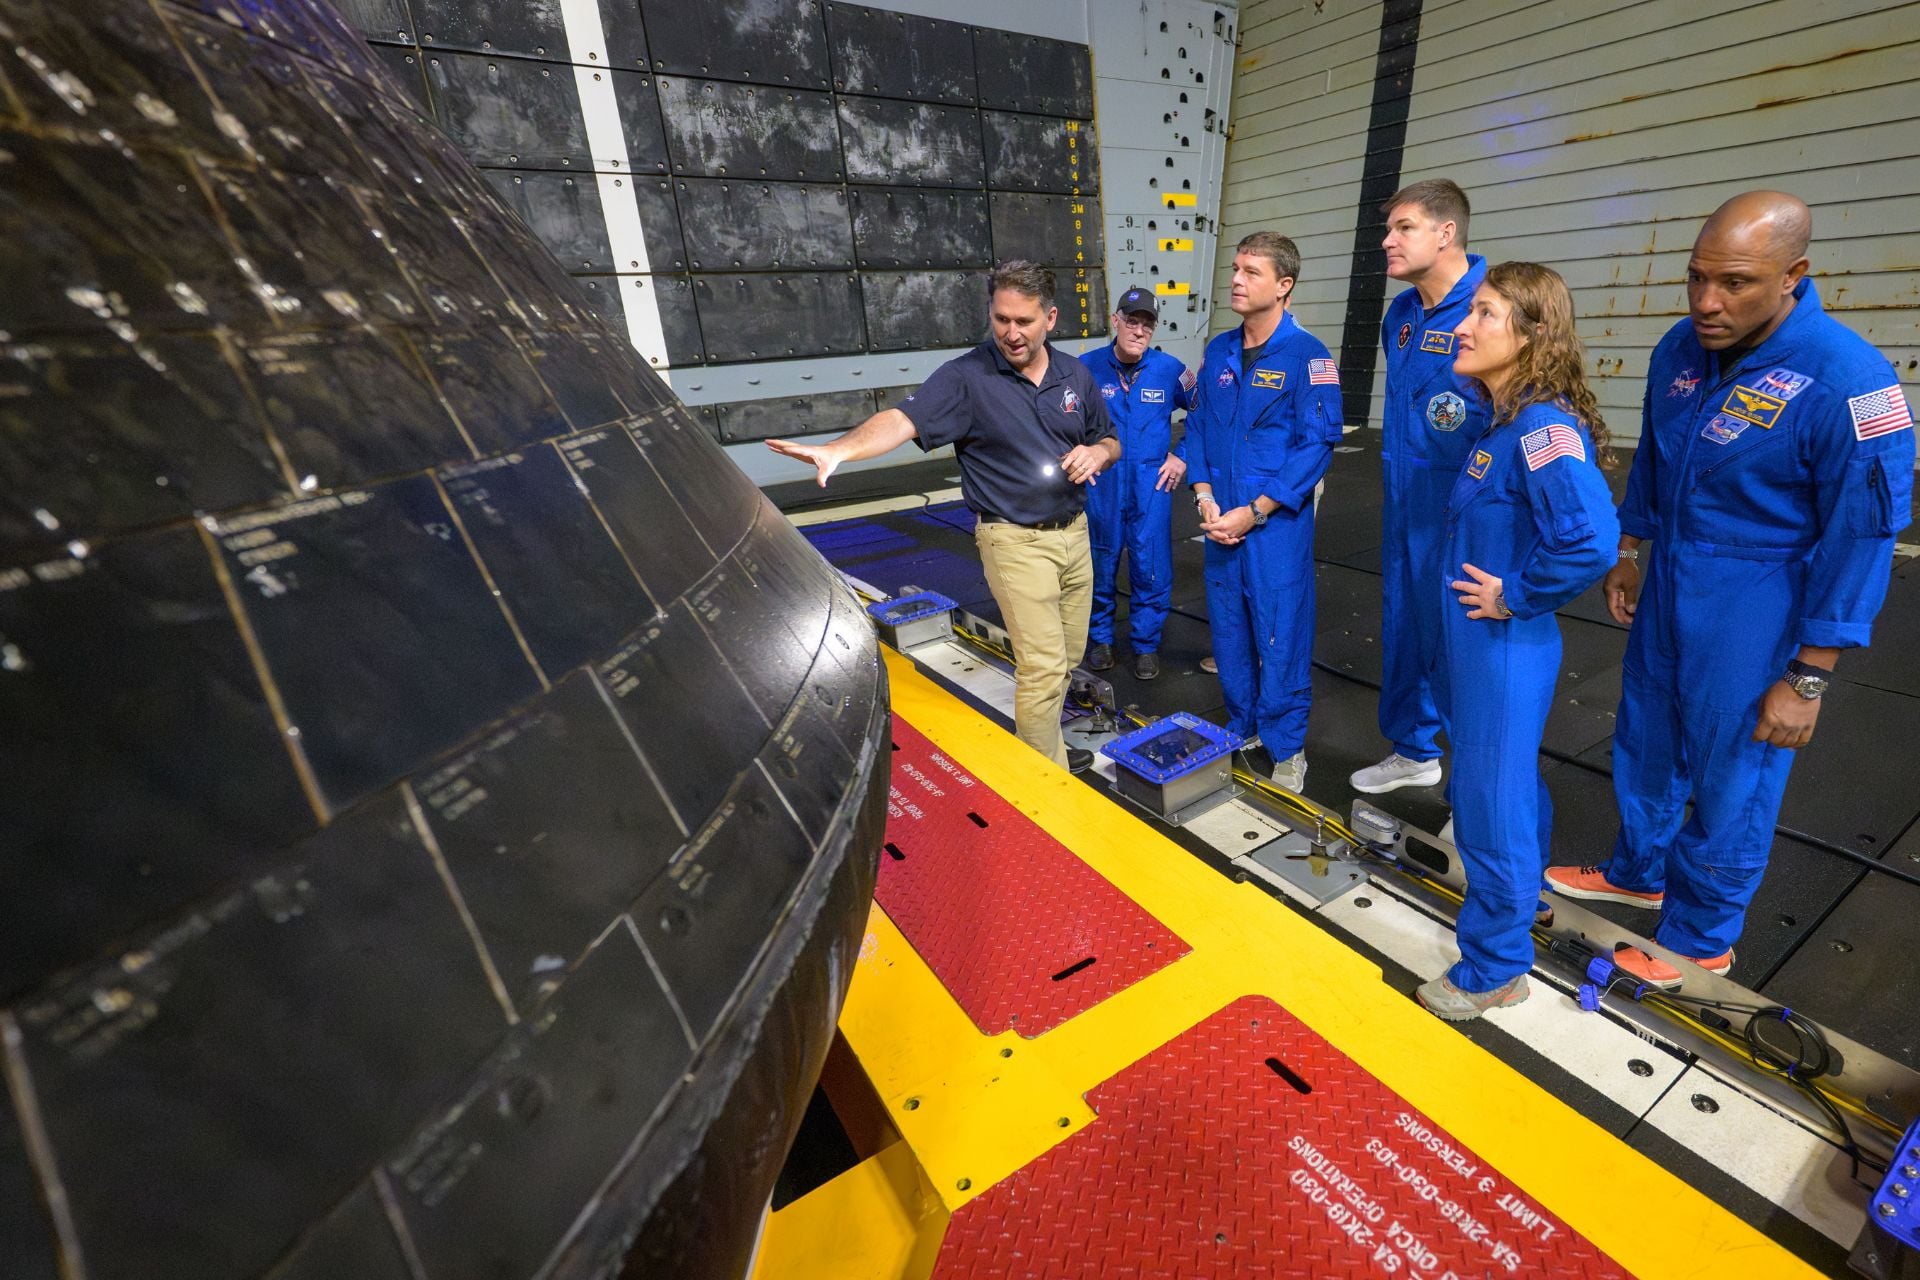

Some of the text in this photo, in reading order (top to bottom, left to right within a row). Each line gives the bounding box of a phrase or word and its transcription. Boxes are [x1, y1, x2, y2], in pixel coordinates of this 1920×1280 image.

[1069, 138, 1075, 148] 8
[1071, 155, 1077, 164] 6
[1072, 171, 1078, 180] 4
[1072, 204, 1084, 213] 3M
[1075, 219, 1081, 229] 8
[1126, 216, 1133, 228] 9
[1076, 235, 1082, 245] 6
[1126, 239, 1134, 251] 8
[1077, 252, 1083, 261] 4
[1078, 268, 1084, 277] 2
[1129, 262, 1134, 274] 7
[1076, 284, 1088, 292] 2M
[1082, 329, 1088, 337] 4
[1394, 1112, 1557, 1242] LIMIT 3 PERSONS
[1287, 1135, 1438, 1270] ORCA OPERATIONS
[1365, 1137, 1521, 1272] SA-2K18-030-103
[1291, 1168, 1402, 1273] SA-2K18-030
